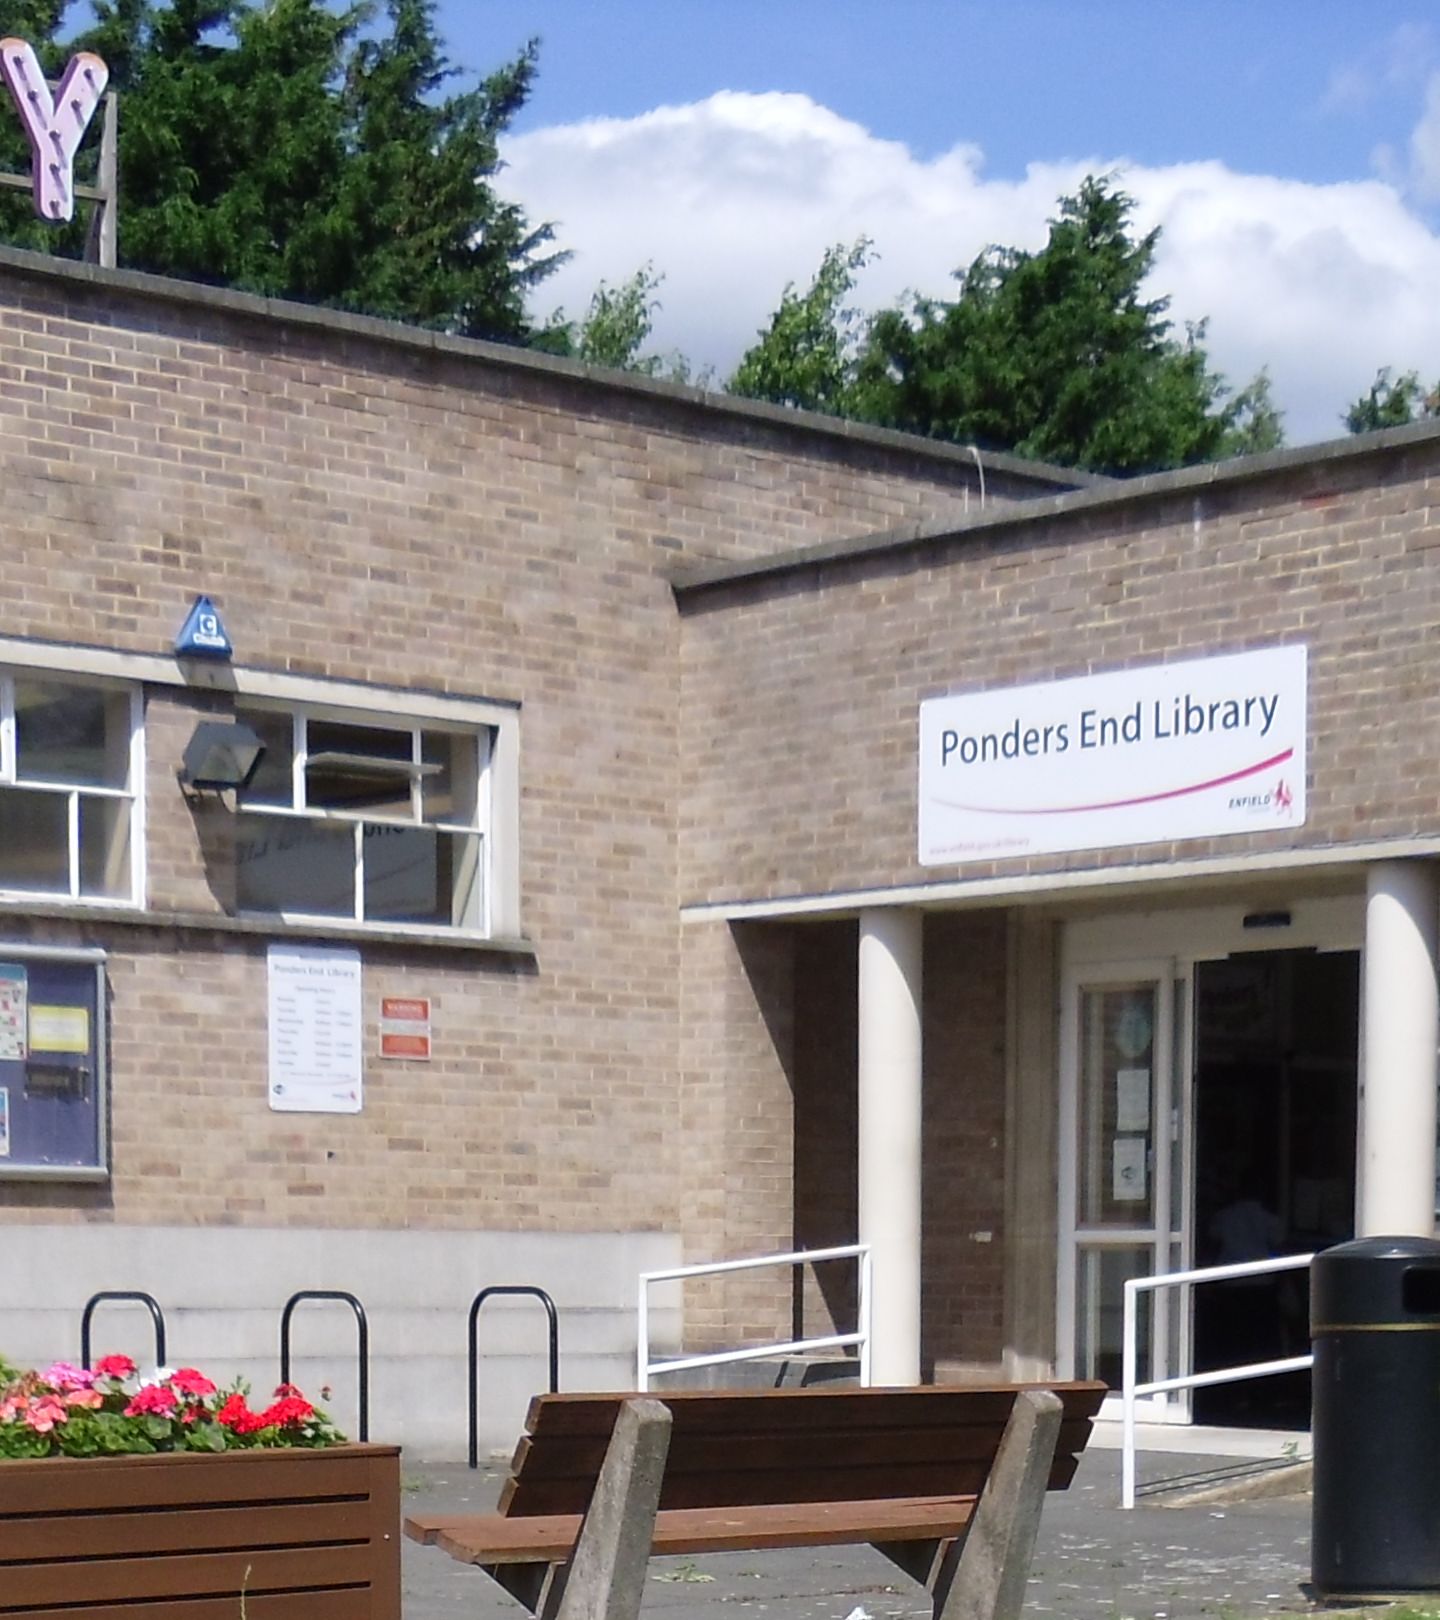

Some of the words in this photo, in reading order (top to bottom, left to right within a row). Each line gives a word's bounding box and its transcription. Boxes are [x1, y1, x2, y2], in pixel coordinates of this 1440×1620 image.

[941, 718, 1069, 767] Ponders
[1080, 701, 1142, 749] End
[1154, 694, 1280, 739] Library
[1228, 794, 1271, 809] ENFIELD
